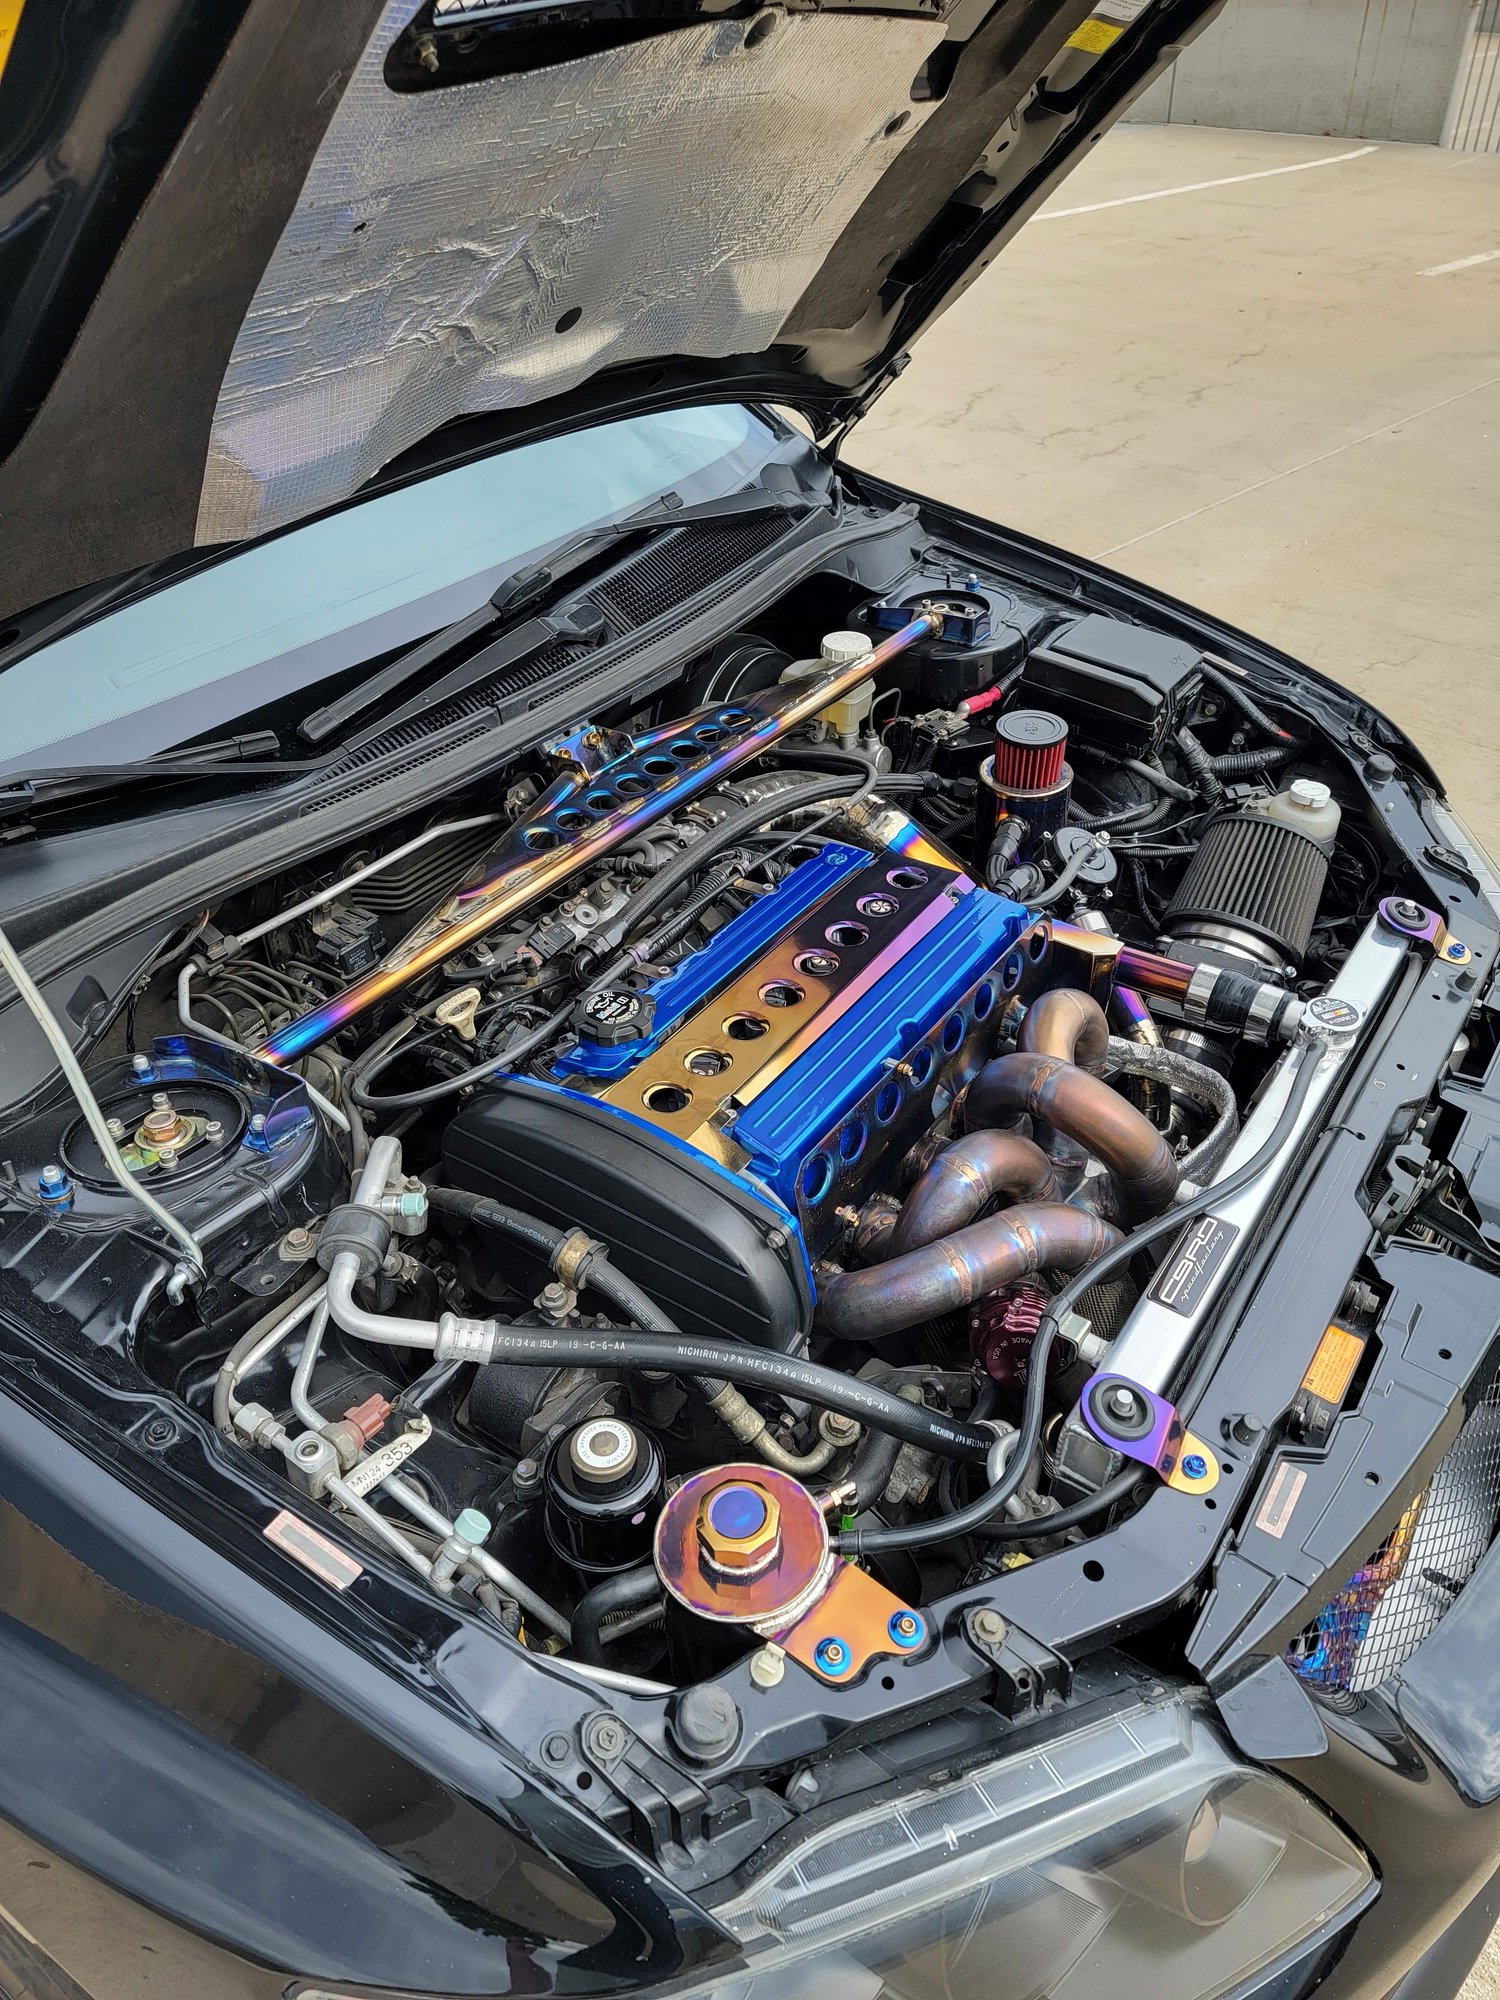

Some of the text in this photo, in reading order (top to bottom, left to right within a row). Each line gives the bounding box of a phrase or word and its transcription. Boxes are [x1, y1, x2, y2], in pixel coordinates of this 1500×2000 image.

[586, 995, 602, 1013] ENGINE
[677, 1346, 719, 1360] NICHIRIN
[992, 1337, 1033, 1360] MADE IN USA
[381, 1441, 413, 1467] 353
